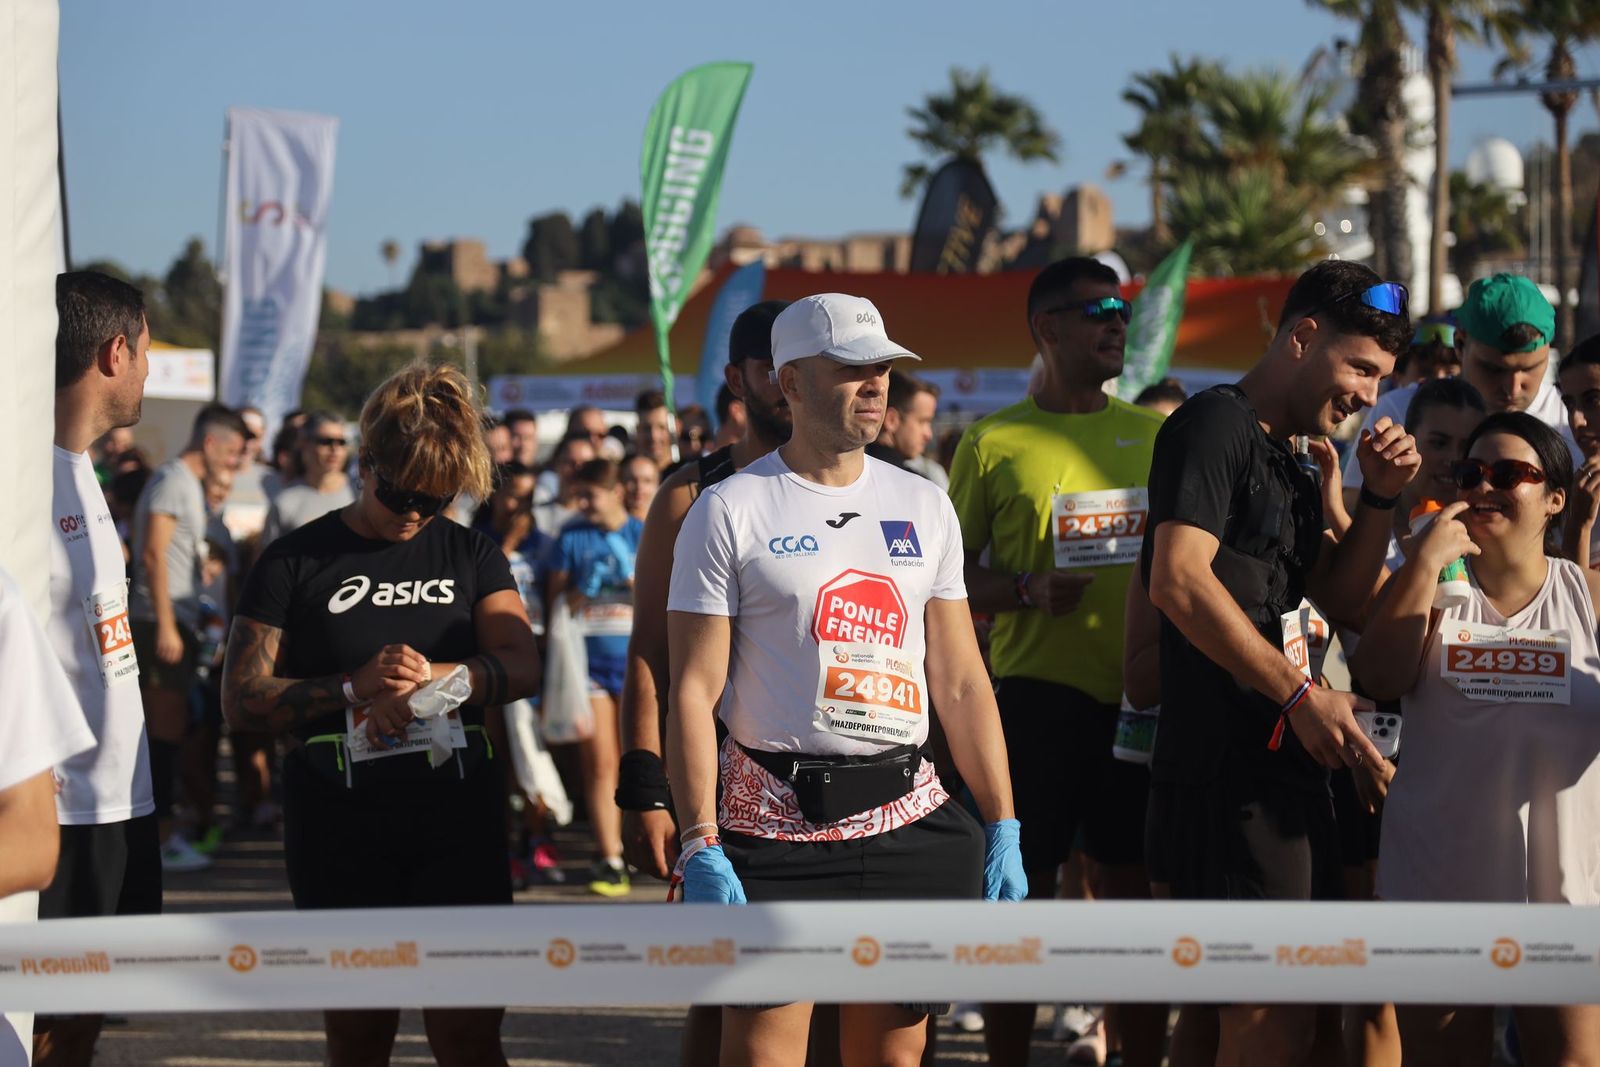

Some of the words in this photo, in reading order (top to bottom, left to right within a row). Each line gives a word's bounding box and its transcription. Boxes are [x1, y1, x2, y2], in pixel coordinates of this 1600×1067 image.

[856, 312, 876, 326] edp
[1065, 514, 1142, 537] 24397
[889, 538, 917, 554] AXA
[890, 559, 925, 567] fundación
[829, 596, 899, 632] PONLE
[101, 618, 132, 650] 243
[1455, 650, 1557, 673] 24939
[835, 672, 915, 709] 24941
[1461, 687, 1554, 699] HAZDEPORTEPORELPLANETA
[21, 956, 110, 976] PLOGGING
[331, 947, 419, 968] PLOGGING
[647, 944, 736, 967] PLOGGING
[954, 943, 1042, 966] PLOGGING
[1276, 944, 1367, 967] PLOGGING
